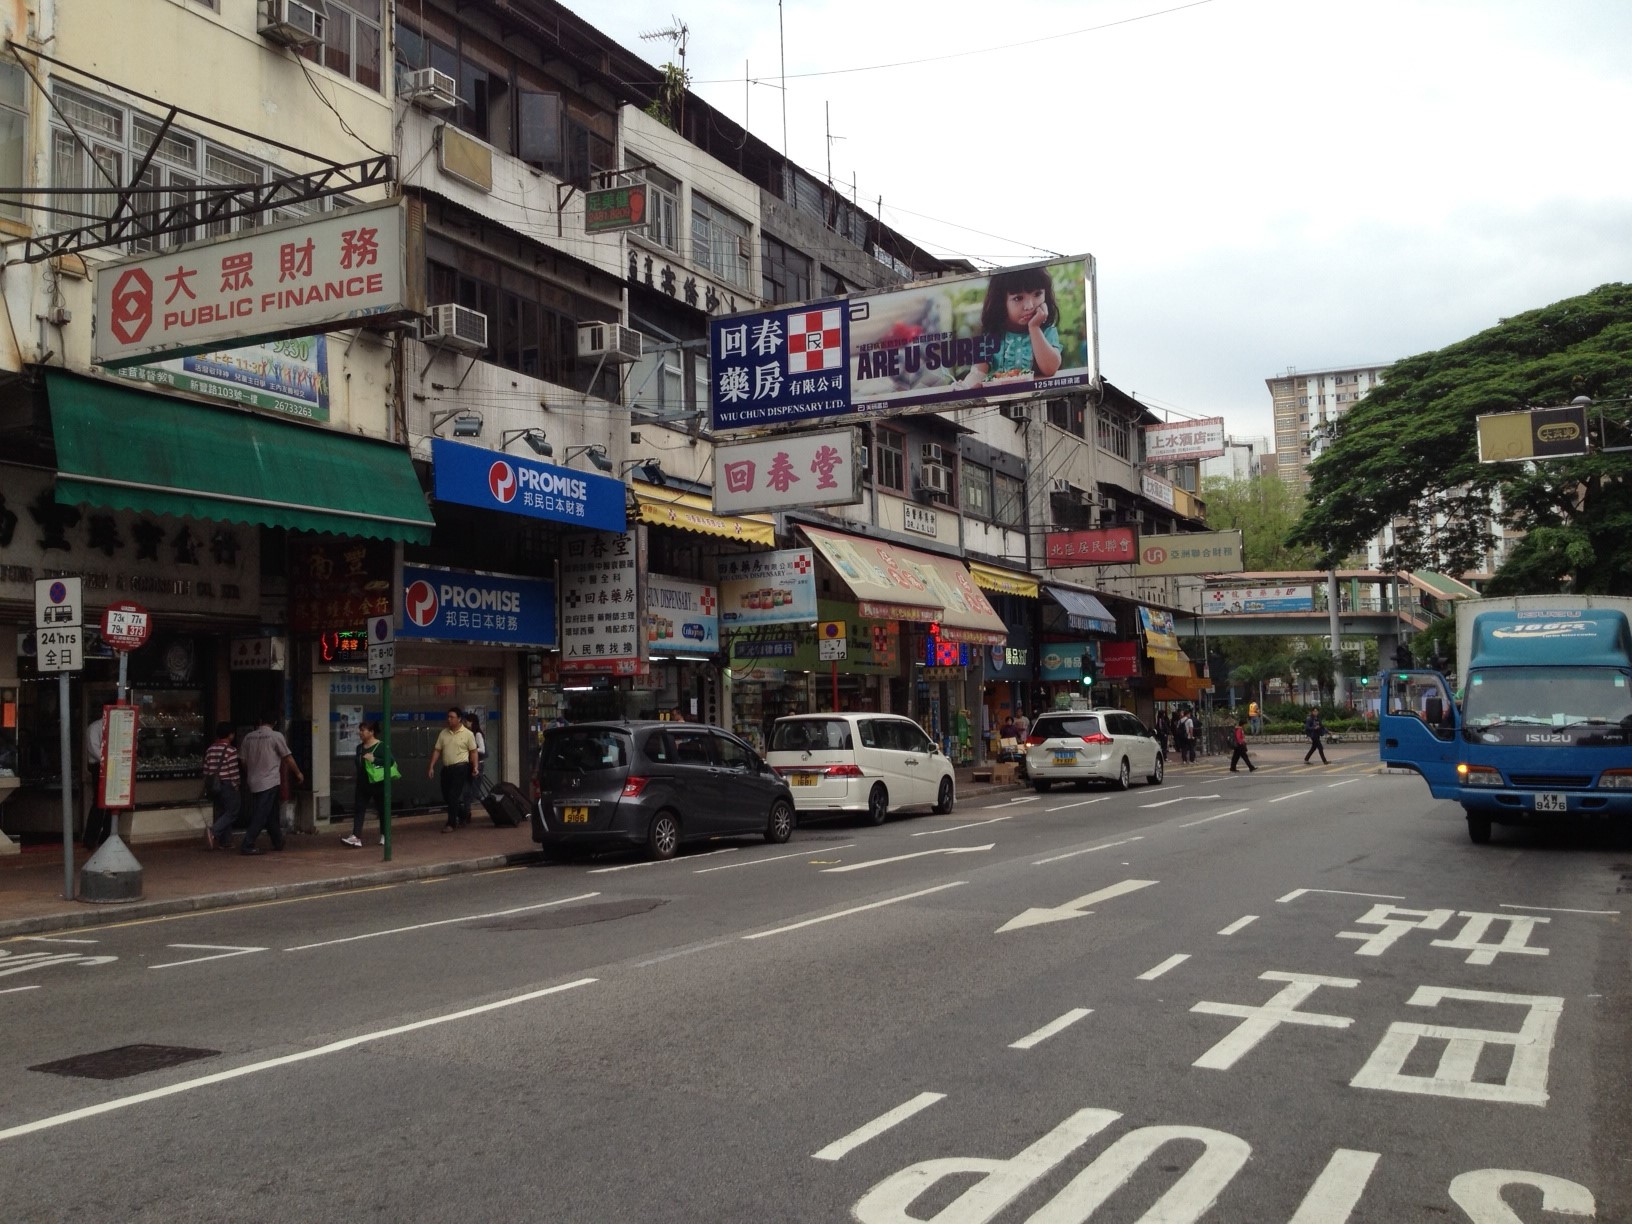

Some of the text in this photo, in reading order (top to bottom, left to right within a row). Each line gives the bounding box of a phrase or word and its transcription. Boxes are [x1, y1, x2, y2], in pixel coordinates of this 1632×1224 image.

[165, 227, 379, 305] 大眾財務
[164, 273, 383, 330] PUBLIC FINANCE
[720, 318, 784, 360] 回春
[857, 347, 900, 381] ARE
[904, 345, 921, 374] U
[719, 361, 843, 403] 藥房 有限公司
[274, 400, 313, 417] 26733263
[720, 399, 846, 422] WIU CHUN DISPENSARY LTD.
[1152, 431, 1207, 449] 上水酒店
[724, 445, 843, 493] 回春堂
[518, 467, 587, 501] PROMISE
[523, 491, 585, 518] 邦民日本財務
[568, 531, 632, 558] 回春堂
[1051, 537, 1131, 556] 北區居民聯會
[749, 570, 786, 580] DISPENSARY
[440, 585, 521, 613] PROMISE
[584, 588, 636, 605] 回春藥房
[445, 611, 518, 631] 邦民日本財務
[1516, 610, 1582, 619] ISUZU
[41, 632, 77, 645] 24 hrs
[130, 627, 144, 636] 373
[568, 642, 633, 657] 人民幣找換
[836, 640, 841, 648] 7
[45, 649, 72, 666] 全日
[837, 651, 846, 659] 12
[330, 683, 376, 694] 3199 1199
[1526, 734, 1572, 743] ISUZU
[1536, 802, 1566, 811] 9476
[1543, 794, 1558, 802] KW
[1336, 903, 1551, 966] 站
[1190, 970, 1565, 1108] 巴士
